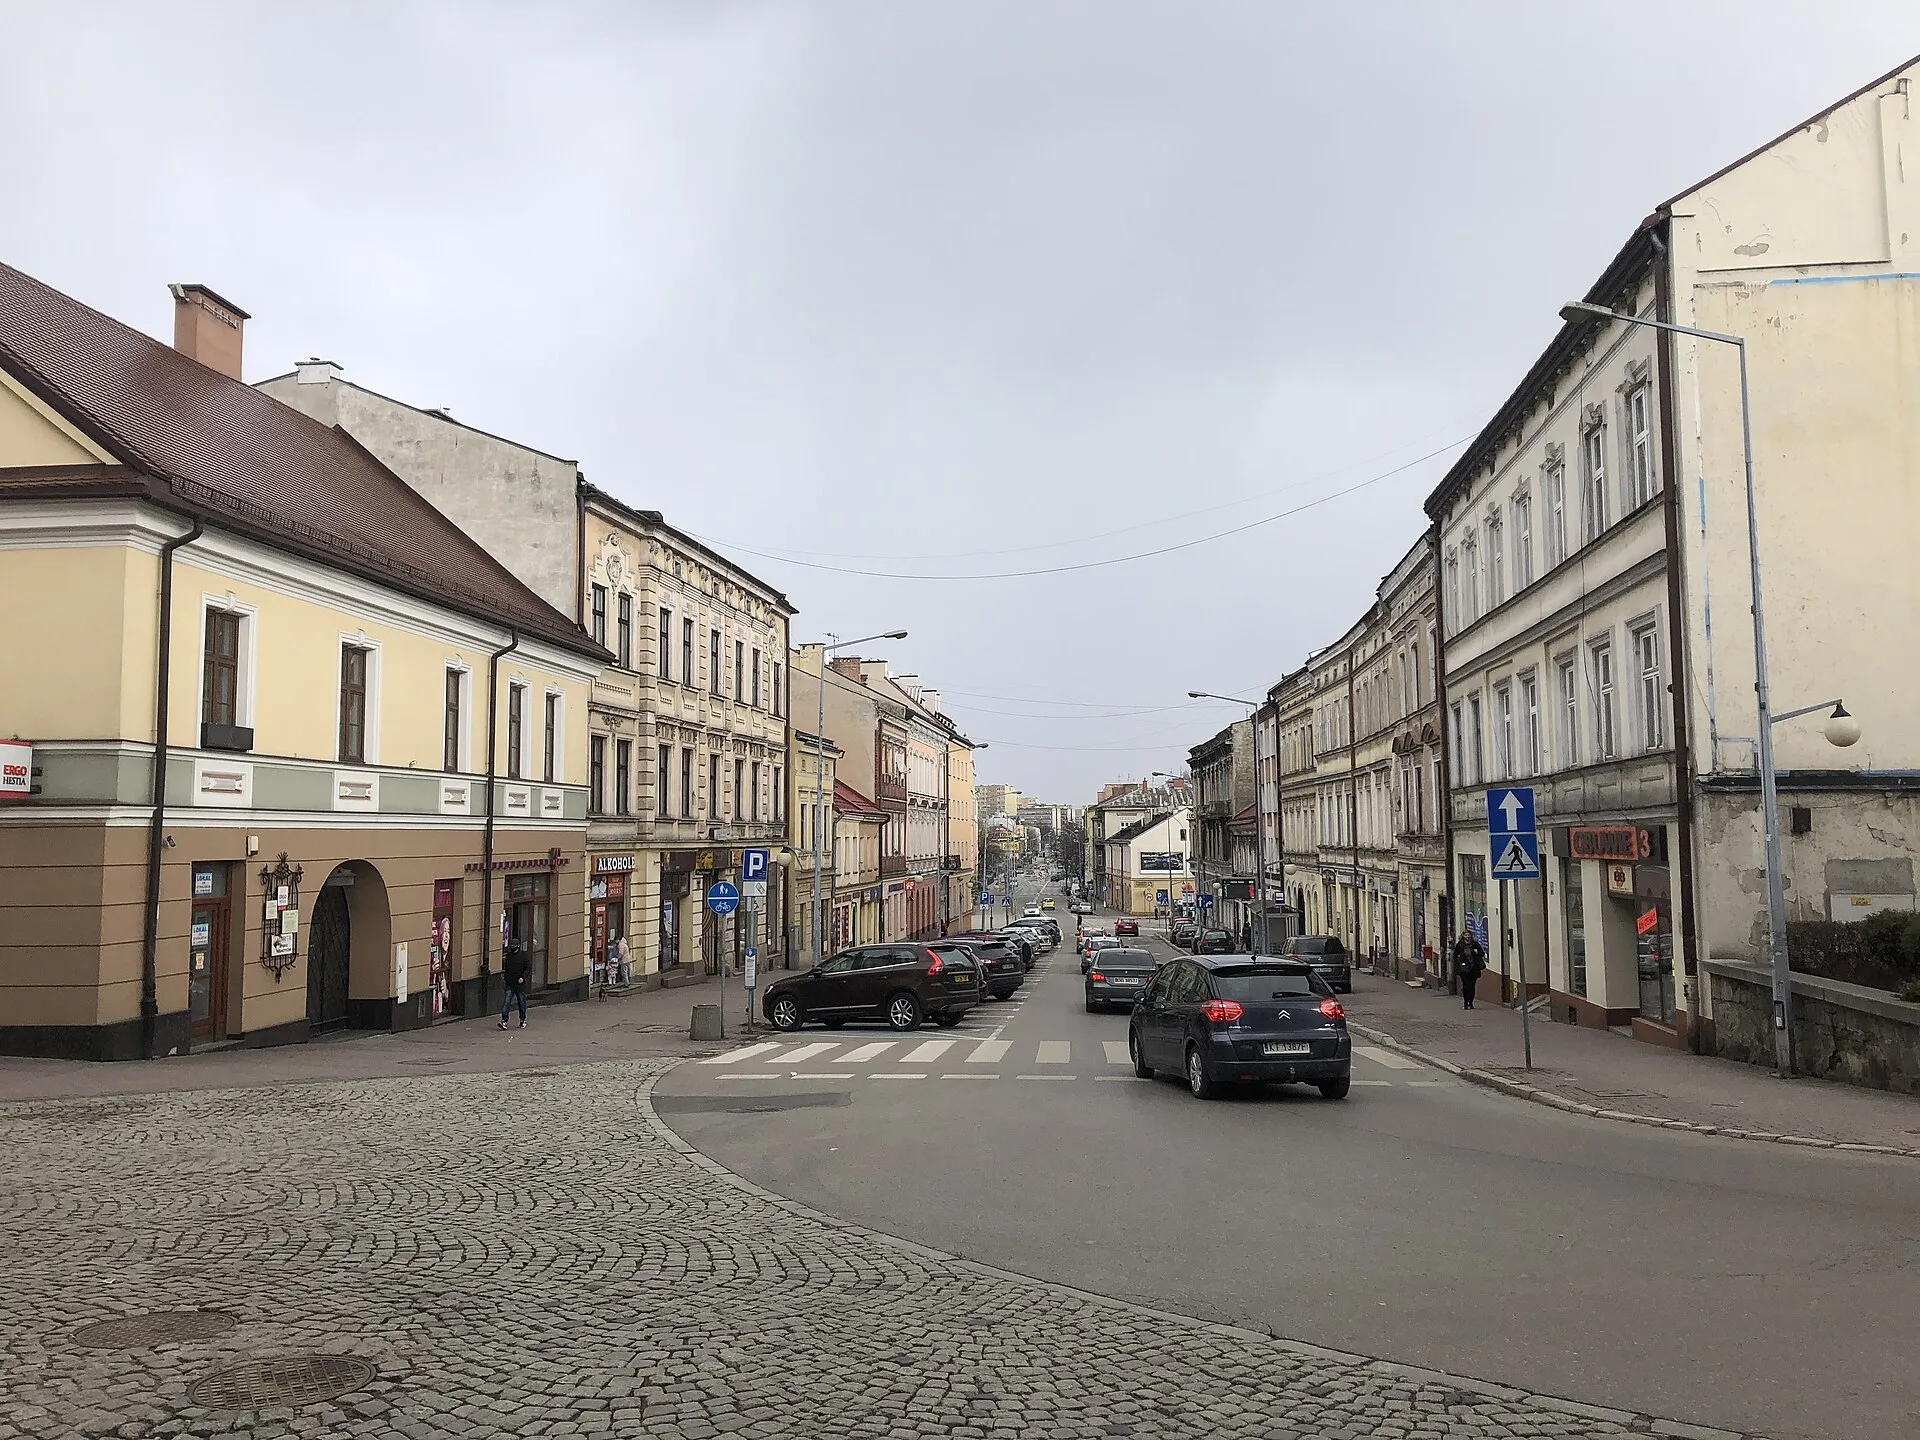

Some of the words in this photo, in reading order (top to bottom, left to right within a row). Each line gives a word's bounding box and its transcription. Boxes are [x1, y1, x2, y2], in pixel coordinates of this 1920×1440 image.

[3, 765, 28, 776] ERGO
[2, 776, 26, 785] HESTIA
[1640, 830, 1651, 858] 3
[598, 856, 636, 871] ALKOHOLE
[748, 852, 764, 877] P
[1268, 1043, 1280, 1052] KT
